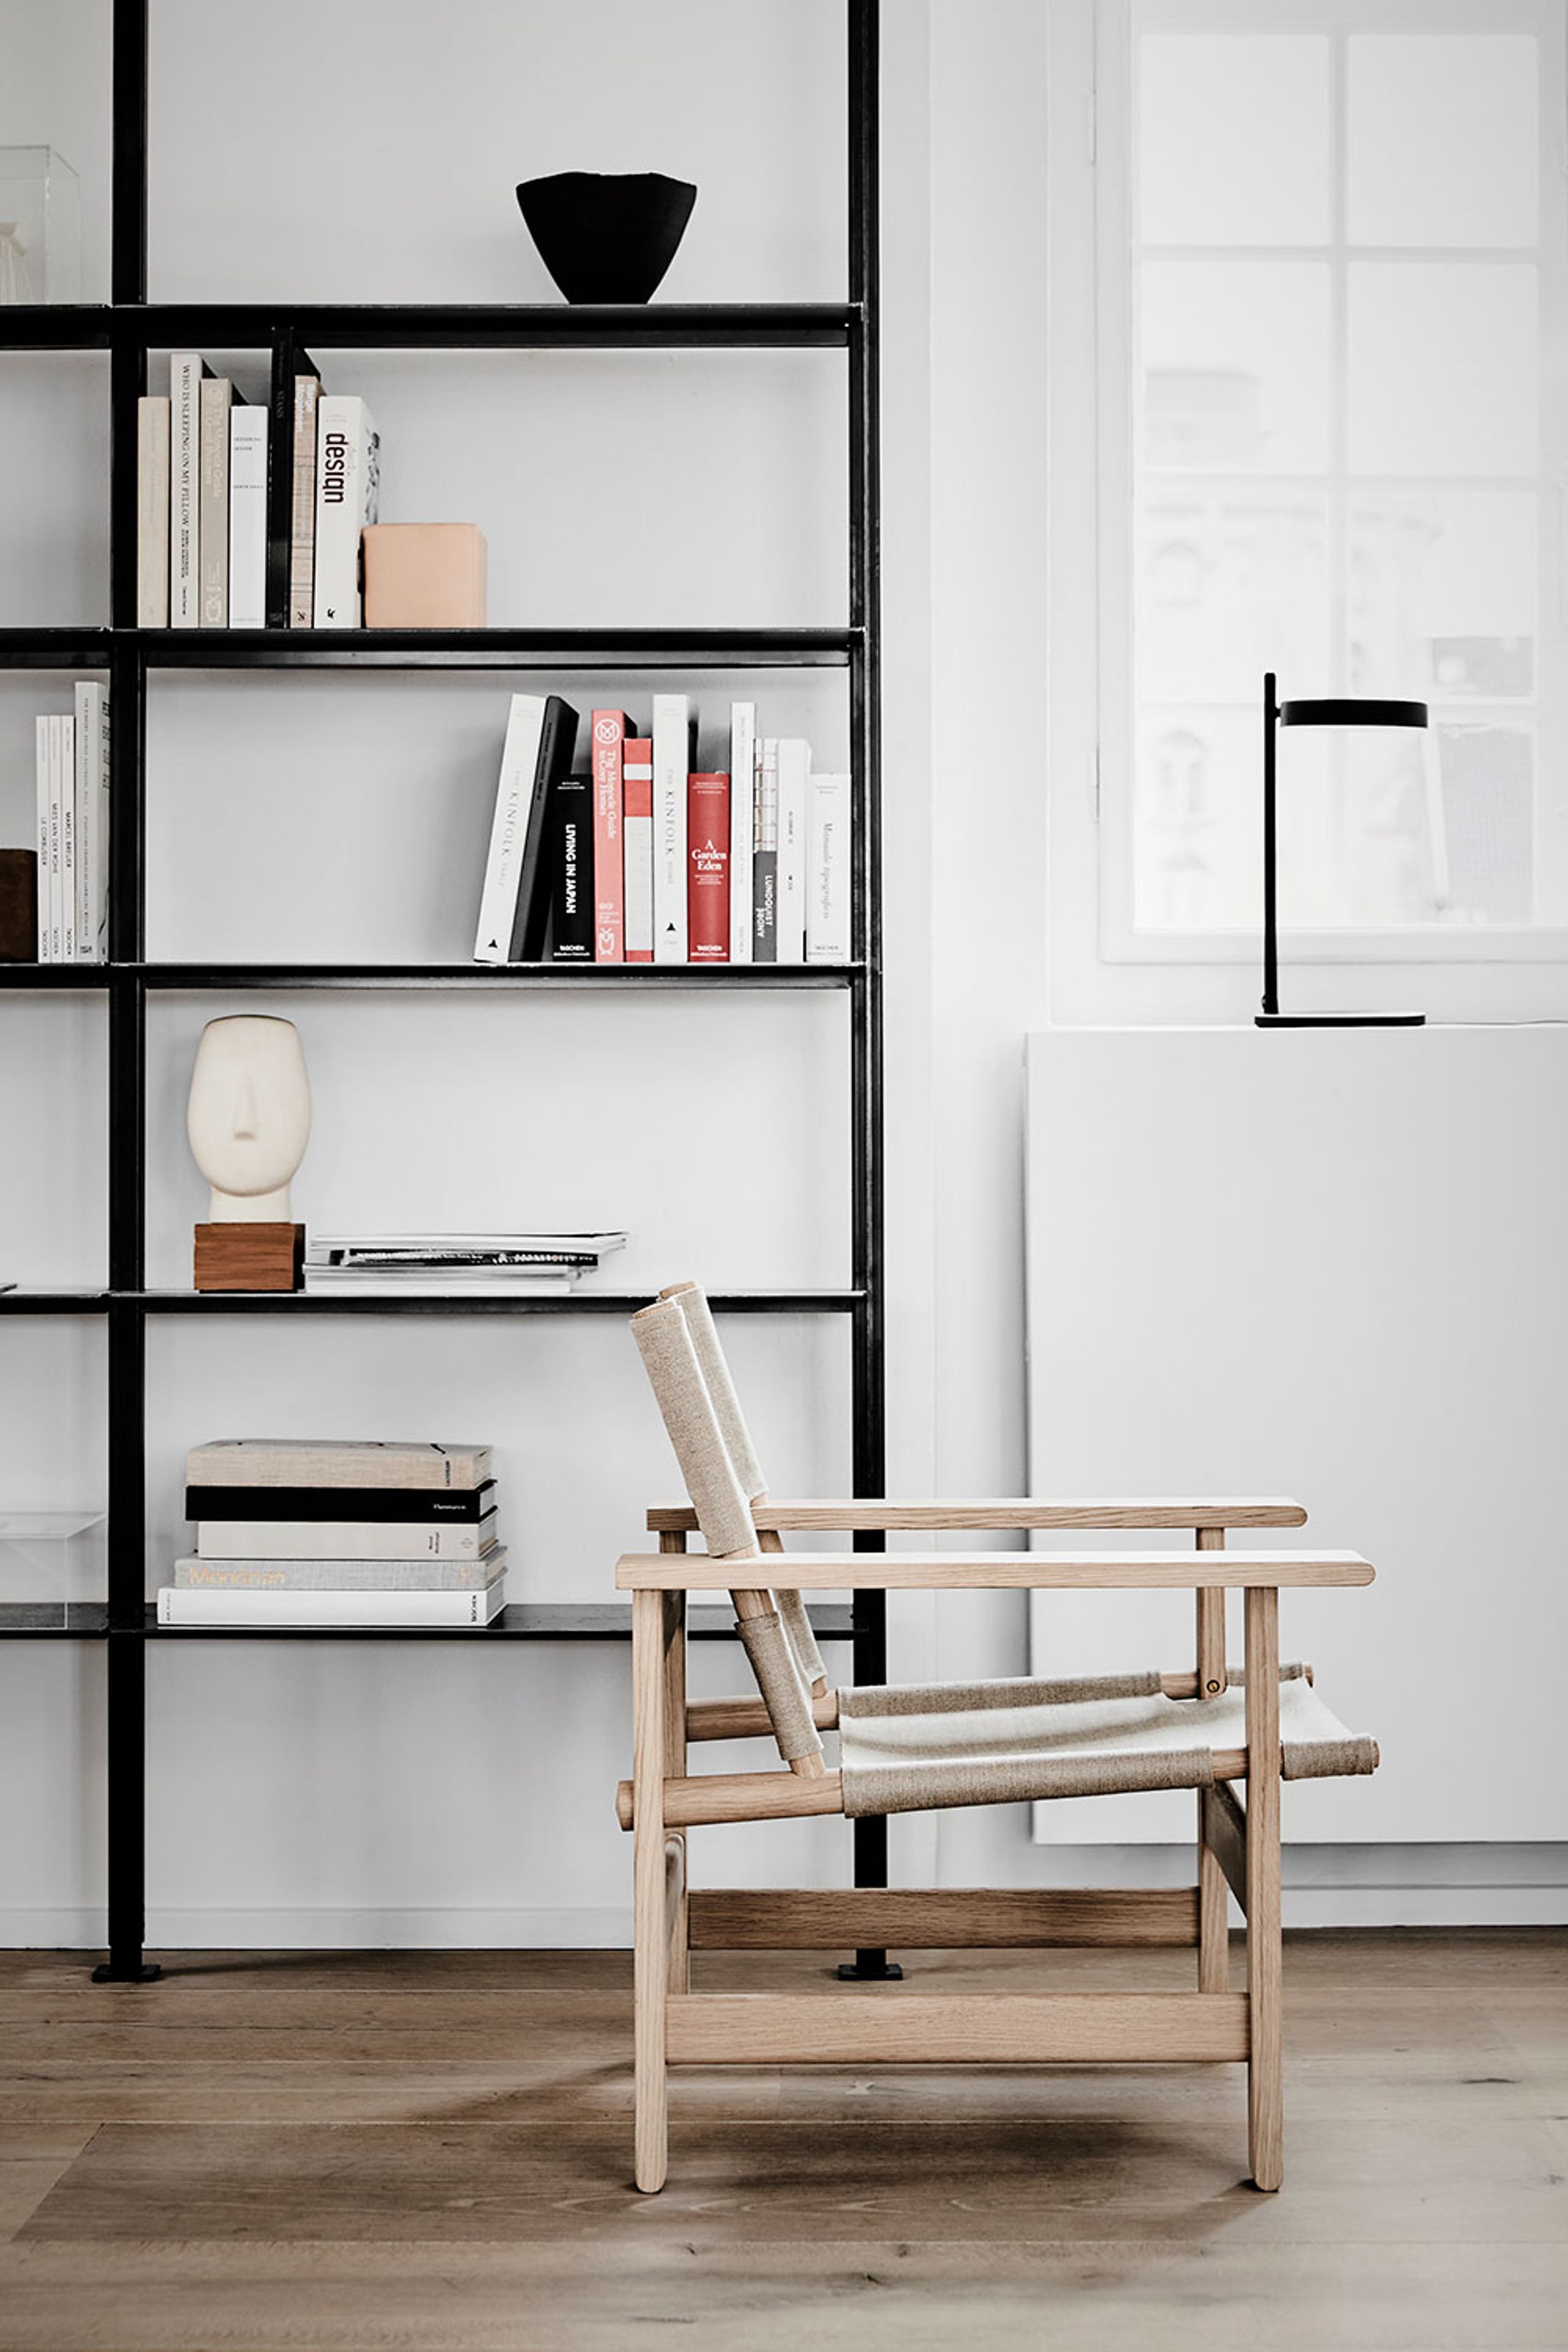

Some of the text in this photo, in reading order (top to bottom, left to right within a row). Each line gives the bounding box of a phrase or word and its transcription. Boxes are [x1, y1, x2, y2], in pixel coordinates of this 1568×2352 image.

[182, 391, 190, 401] IS
[182, 453, 190, 467] ON
[323, 432, 349, 503] design
[182, 470, 190, 483] MY
[606, 771, 617, 810] Monocle
[502, 791, 520, 856] KINFOLK
[607, 811, 617, 839] Guide
[665, 791, 676, 856] KINFOLK
[706, 840, 714, 850] A
[692, 849, 727, 861] Garden
[566, 824, 576, 914] LIVING IN JAPAN
[698, 861, 722, 870] Eden
[189, 1567, 285, 1585] Mondrian
